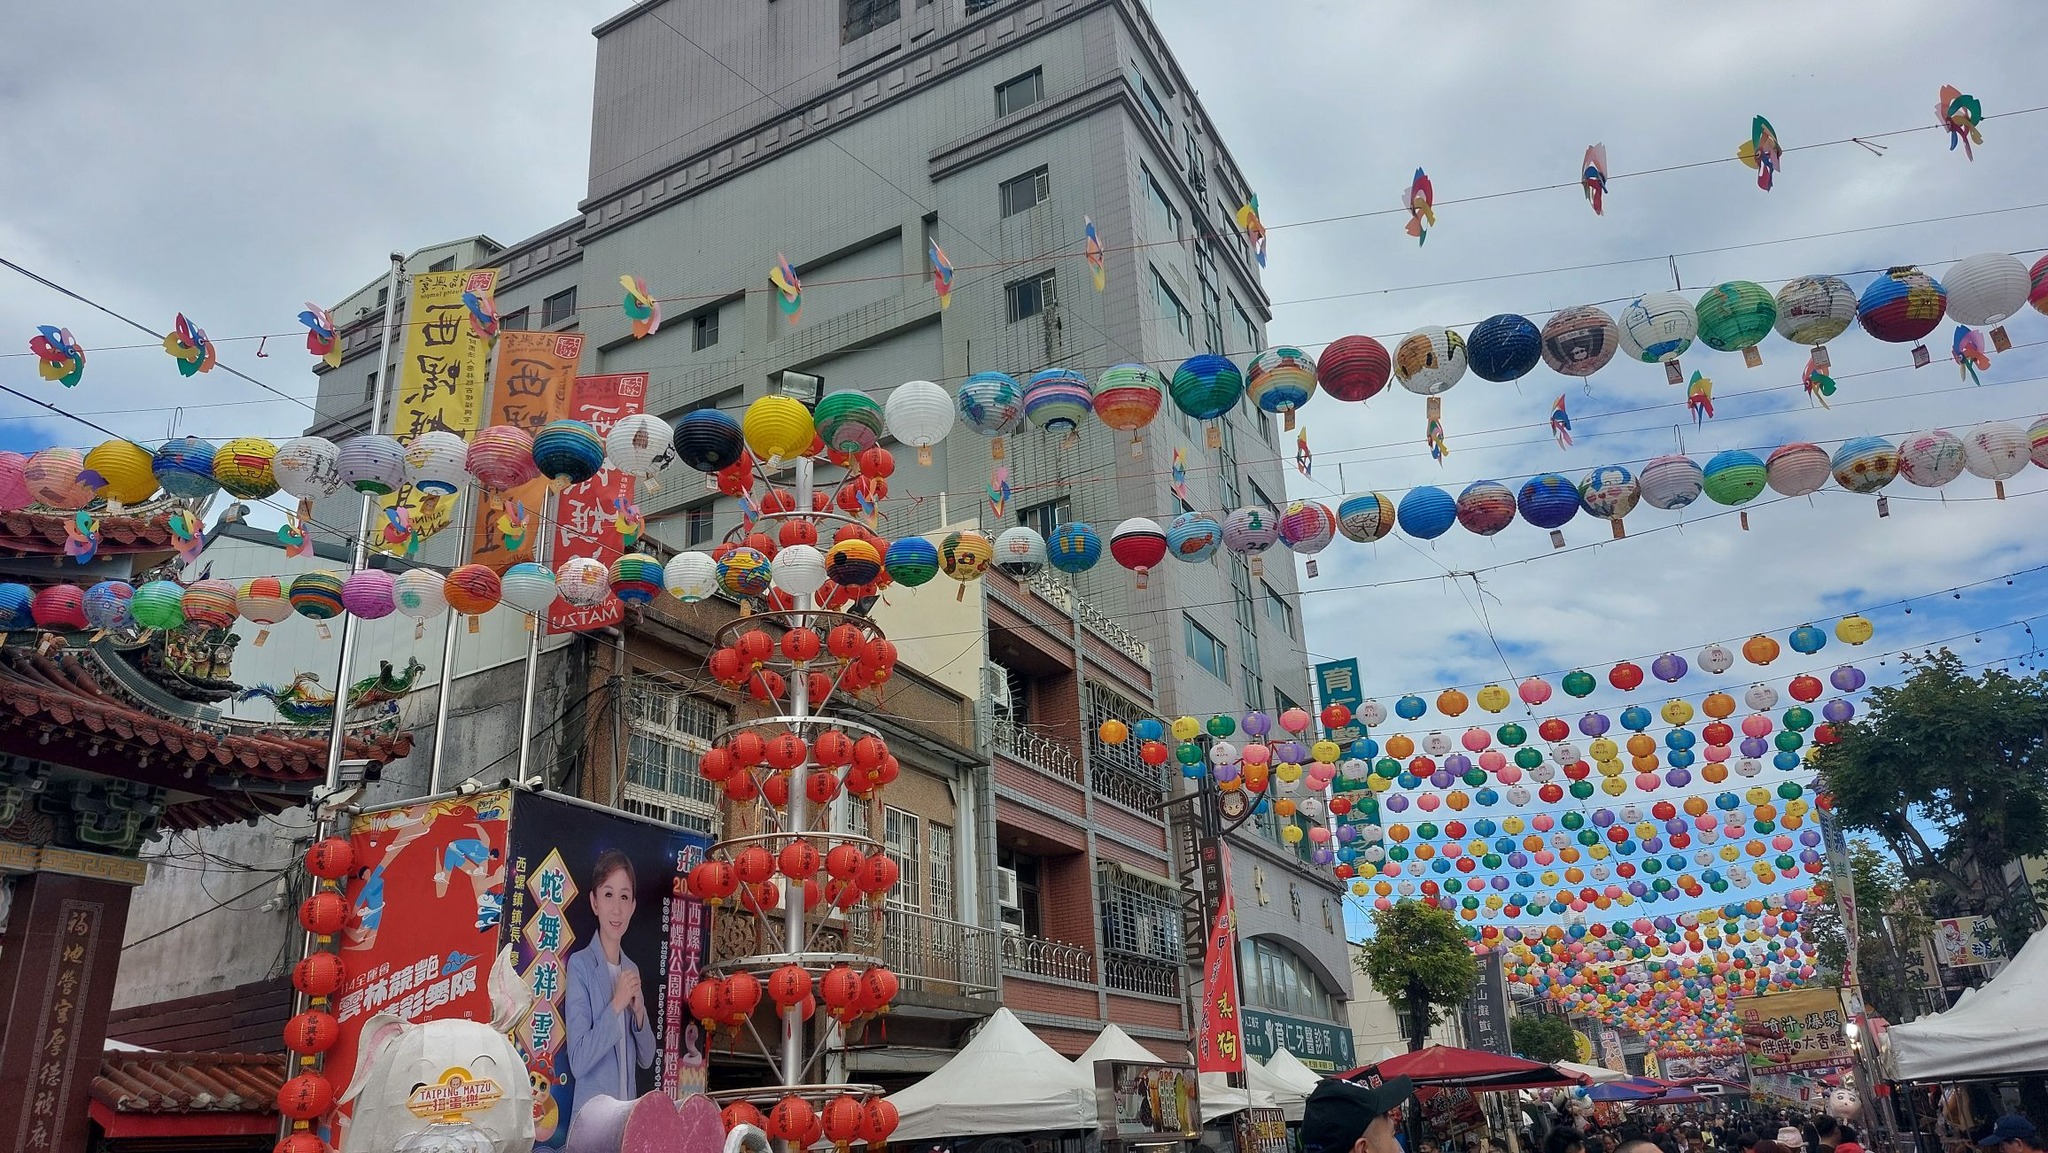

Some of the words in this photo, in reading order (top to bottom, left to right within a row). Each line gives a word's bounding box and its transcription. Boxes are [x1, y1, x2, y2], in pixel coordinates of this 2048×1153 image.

[532, 868, 565, 1050] 蛇舞祥雲
[1476, 959, 1497, 1054] 阿里山鐵道紅
[420, 1087, 459, 1101] TAIPING
[463, 1082, 491, 1096] MATZU
